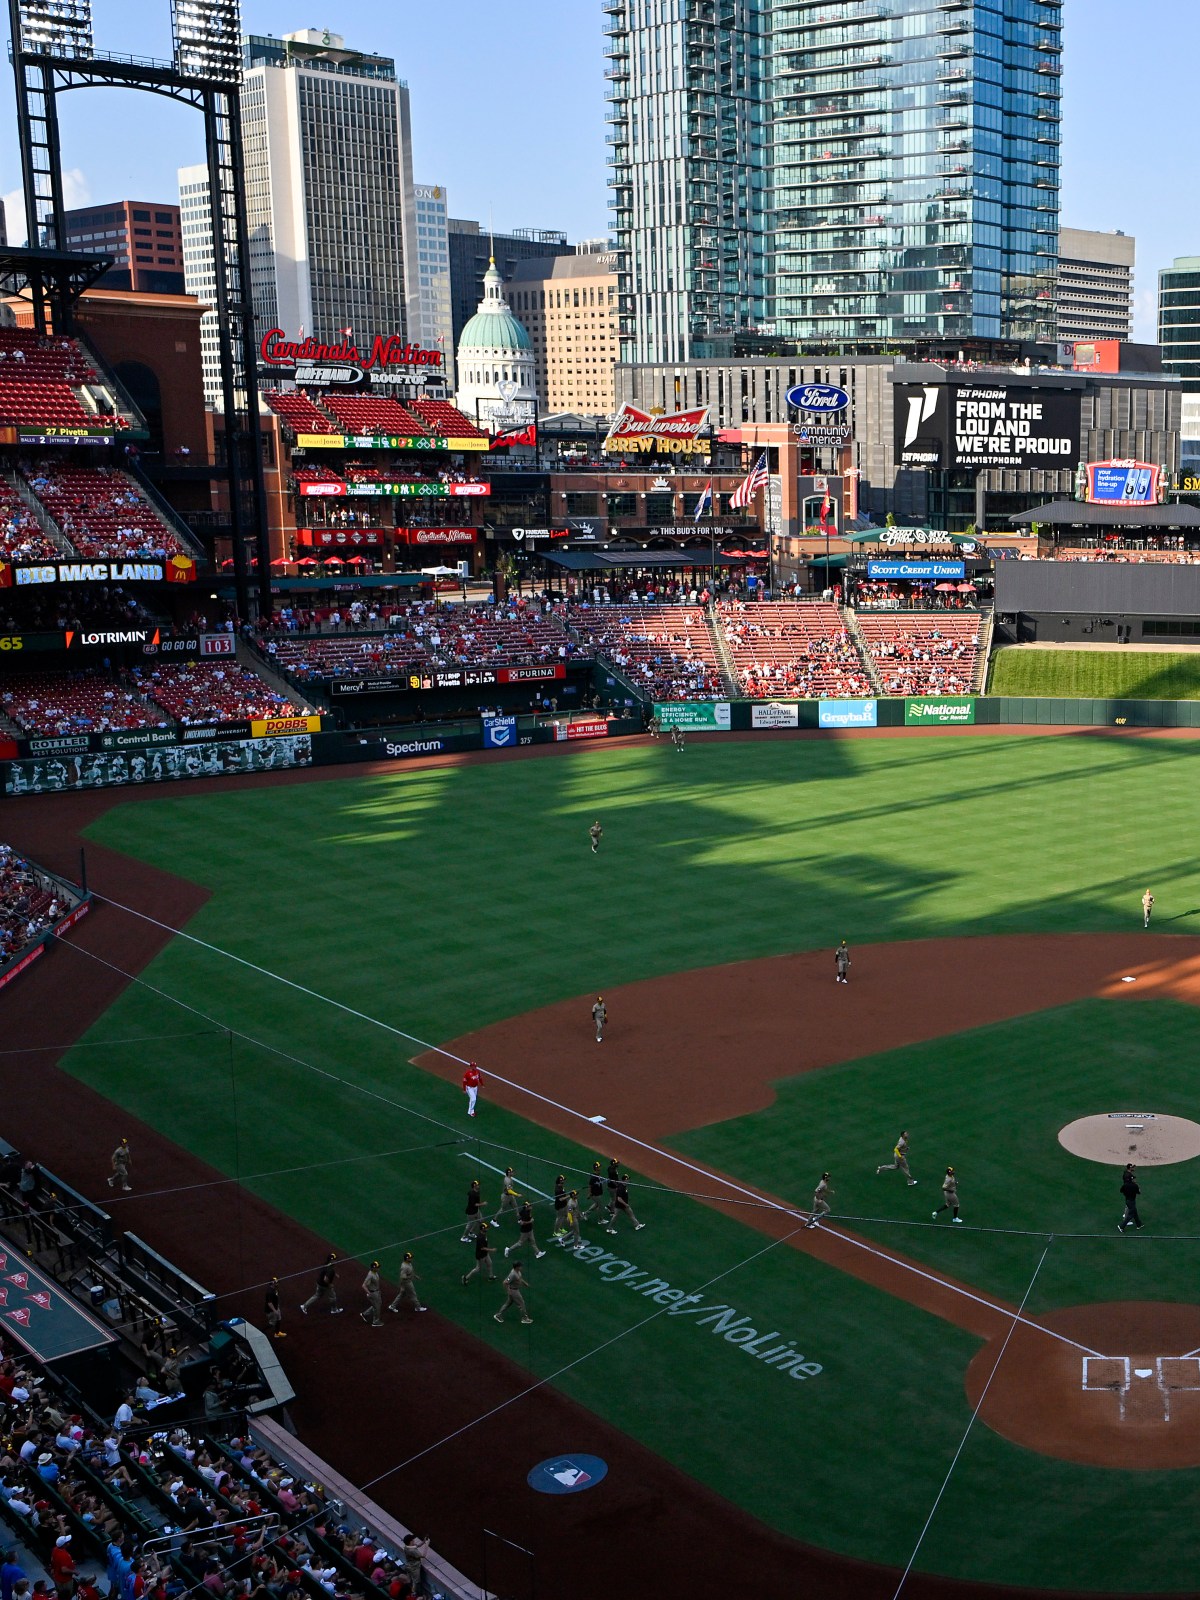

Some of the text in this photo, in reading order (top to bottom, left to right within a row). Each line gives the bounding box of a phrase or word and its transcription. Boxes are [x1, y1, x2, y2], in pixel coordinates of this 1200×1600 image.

[260, 328, 443, 368] Cardinals Nation
[295, 367, 352, 381] HOFFMANN
[370, 373, 427, 384] ROOFTOP
[800, 387, 838, 406] Ford
[956, 389, 1006, 400] 1ST PHORM
[956, 401, 1042, 419] FROM THE
[606, 413, 711, 434] Budweiser
[956, 420, 1030, 436] LOU AND
[794, 424, 850, 438] Community
[606, 438, 712, 454] BREW HOUSE
[956, 436, 1072, 454] WE'RE PROUD
[902, 453, 938, 462] 1ST PHORM
[956, 456, 1022, 464] #IAM1STPHORM
[888, 526, 914, 536] SCOTT
[16, 564, 163, 585] BIG MAC LAND
[871, 565, 961, 574] SCOTT CREDIT UNION
[82, 632, 146, 645] LOTRIMIN
[162, 640, 196, 651] GO GO GO
[207, 641, 229, 652] 103
[923, 704, 970, 715] National
[484, 717, 515, 727] CarShield
[822, 712, 873, 724] GraybaR
[267, 720, 307, 730] DOBBS
[117, 731, 176, 744] Central Bank
[184, 728, 216, 740] LINDENWOOD
[32, 736, 88, 748] ROTTLER
[387, 741, 440, 756] Spectrum
